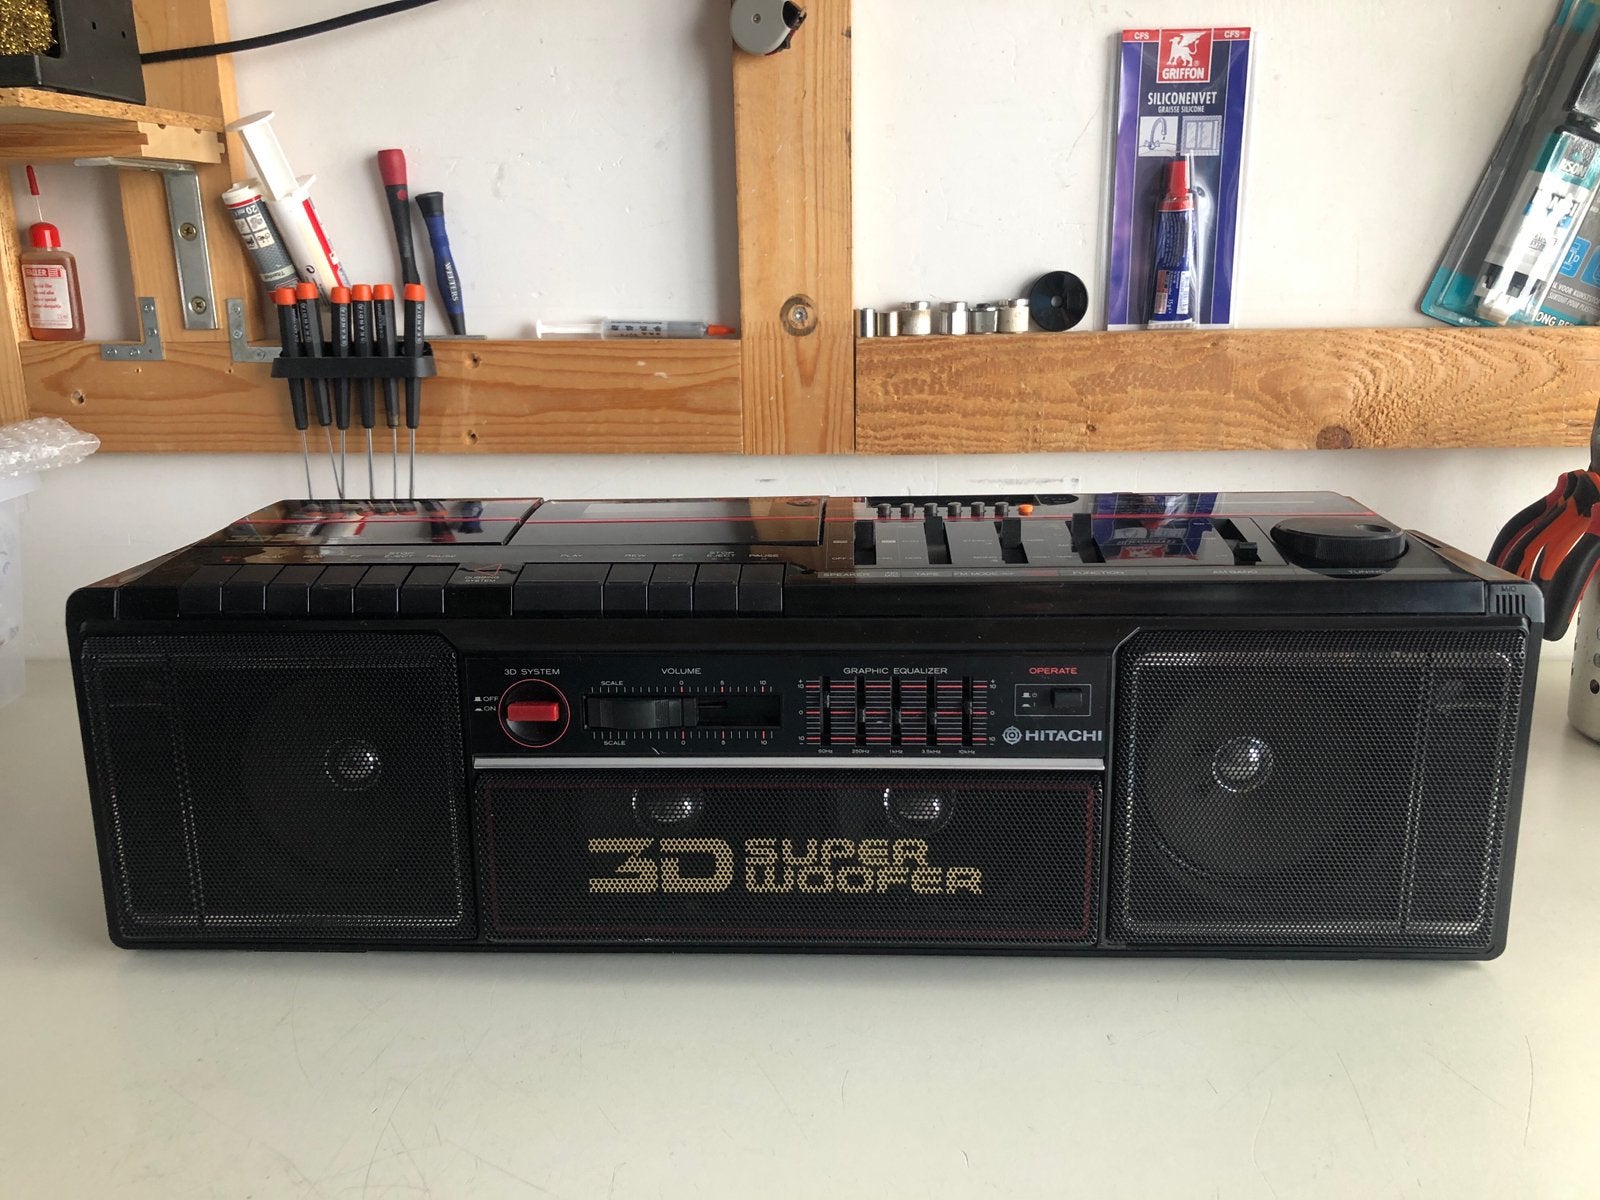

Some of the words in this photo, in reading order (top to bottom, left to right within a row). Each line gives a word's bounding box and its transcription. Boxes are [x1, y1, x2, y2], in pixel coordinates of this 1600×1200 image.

[1134, 32, 1149, 40] CFS
[1224, 30, 1240, 38] CFS
[1162, 67, 1204, 79] GRIFFON
[1147, 91, 1217, 105] SILICONENVET
[1158, 105, 1180, 113] GRAISSE
[1181, 105, 1205, 113] SILICONE
[504, 668, 517, 676] 3D
[521, 668, 561, 676] SYSTEM
[661, 667, 702, 675] VOLUME
[843, 667, 889, 675] GRAPHIC
[893, 667, 949, 675] EQUALIZER
[1028, 667, 1078, 675] OPERATE
[1025, 729, 1103, 742] HITACHI
[588, 838, 734, 893] 3D
[745, 838, 929, 866] SUPER
[745, 866, 983, 894] WOOFER
